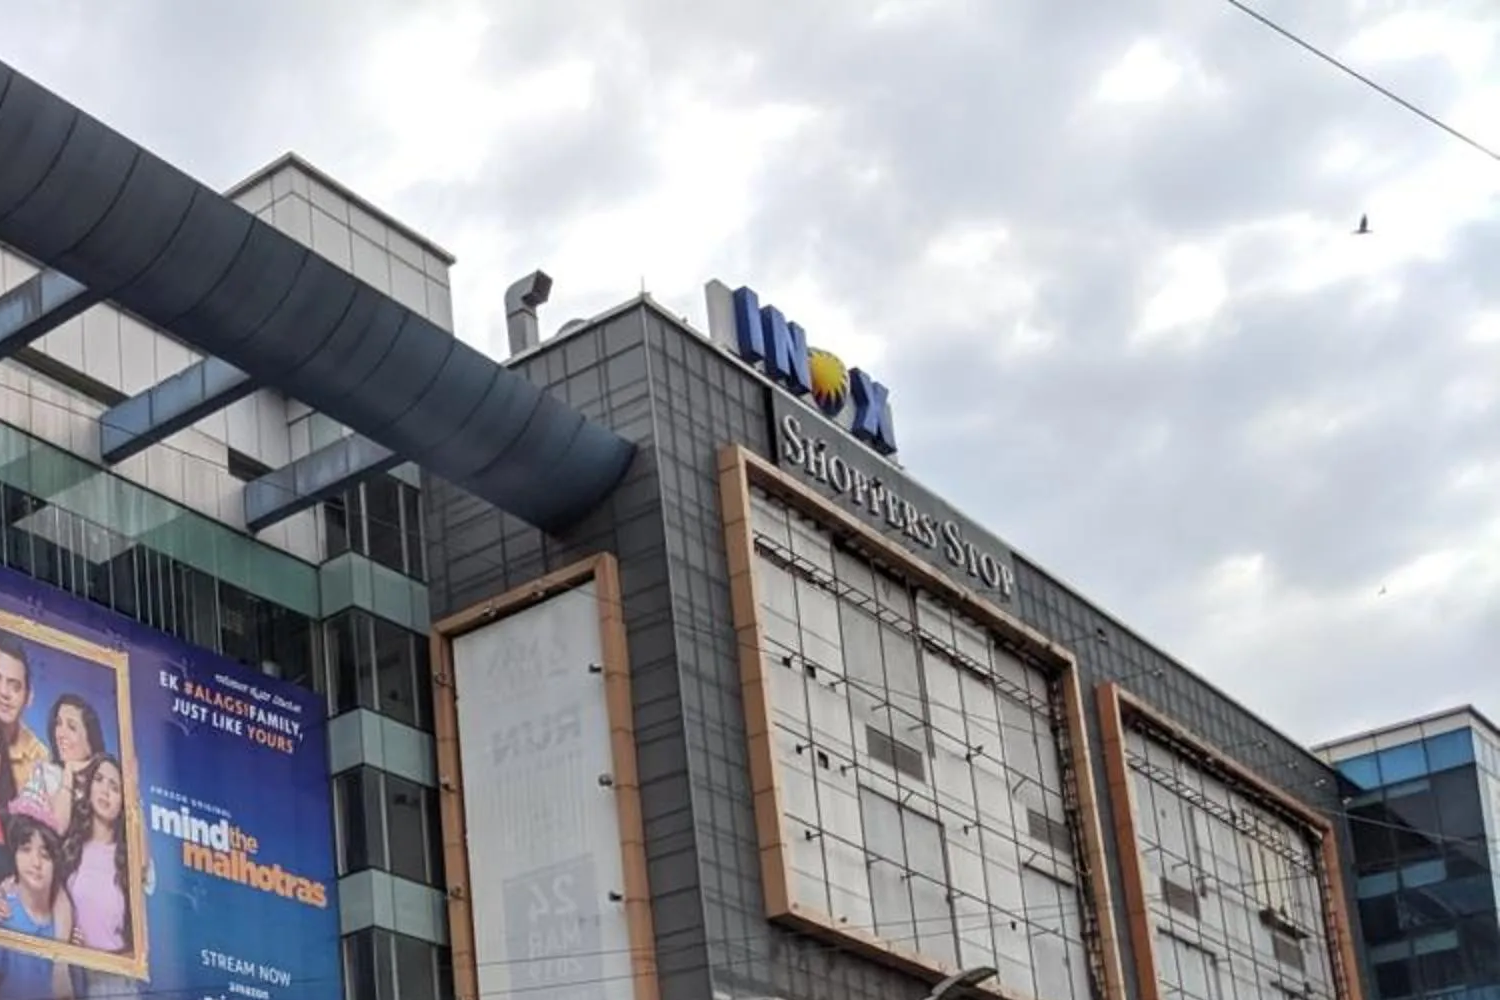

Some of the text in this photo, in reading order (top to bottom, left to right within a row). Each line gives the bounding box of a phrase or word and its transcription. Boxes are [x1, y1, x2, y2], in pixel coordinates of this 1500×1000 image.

[940, 517, 1014, 598] STOP
[159, 670, 179, 691] EK
[172, 698, 293, 754] JUST LIKE YOURS
[151, 804, 258, 854] mind the
[183, 841, 328, 909] malhotras
[201, 949, 291, 987] STREAM NOW
